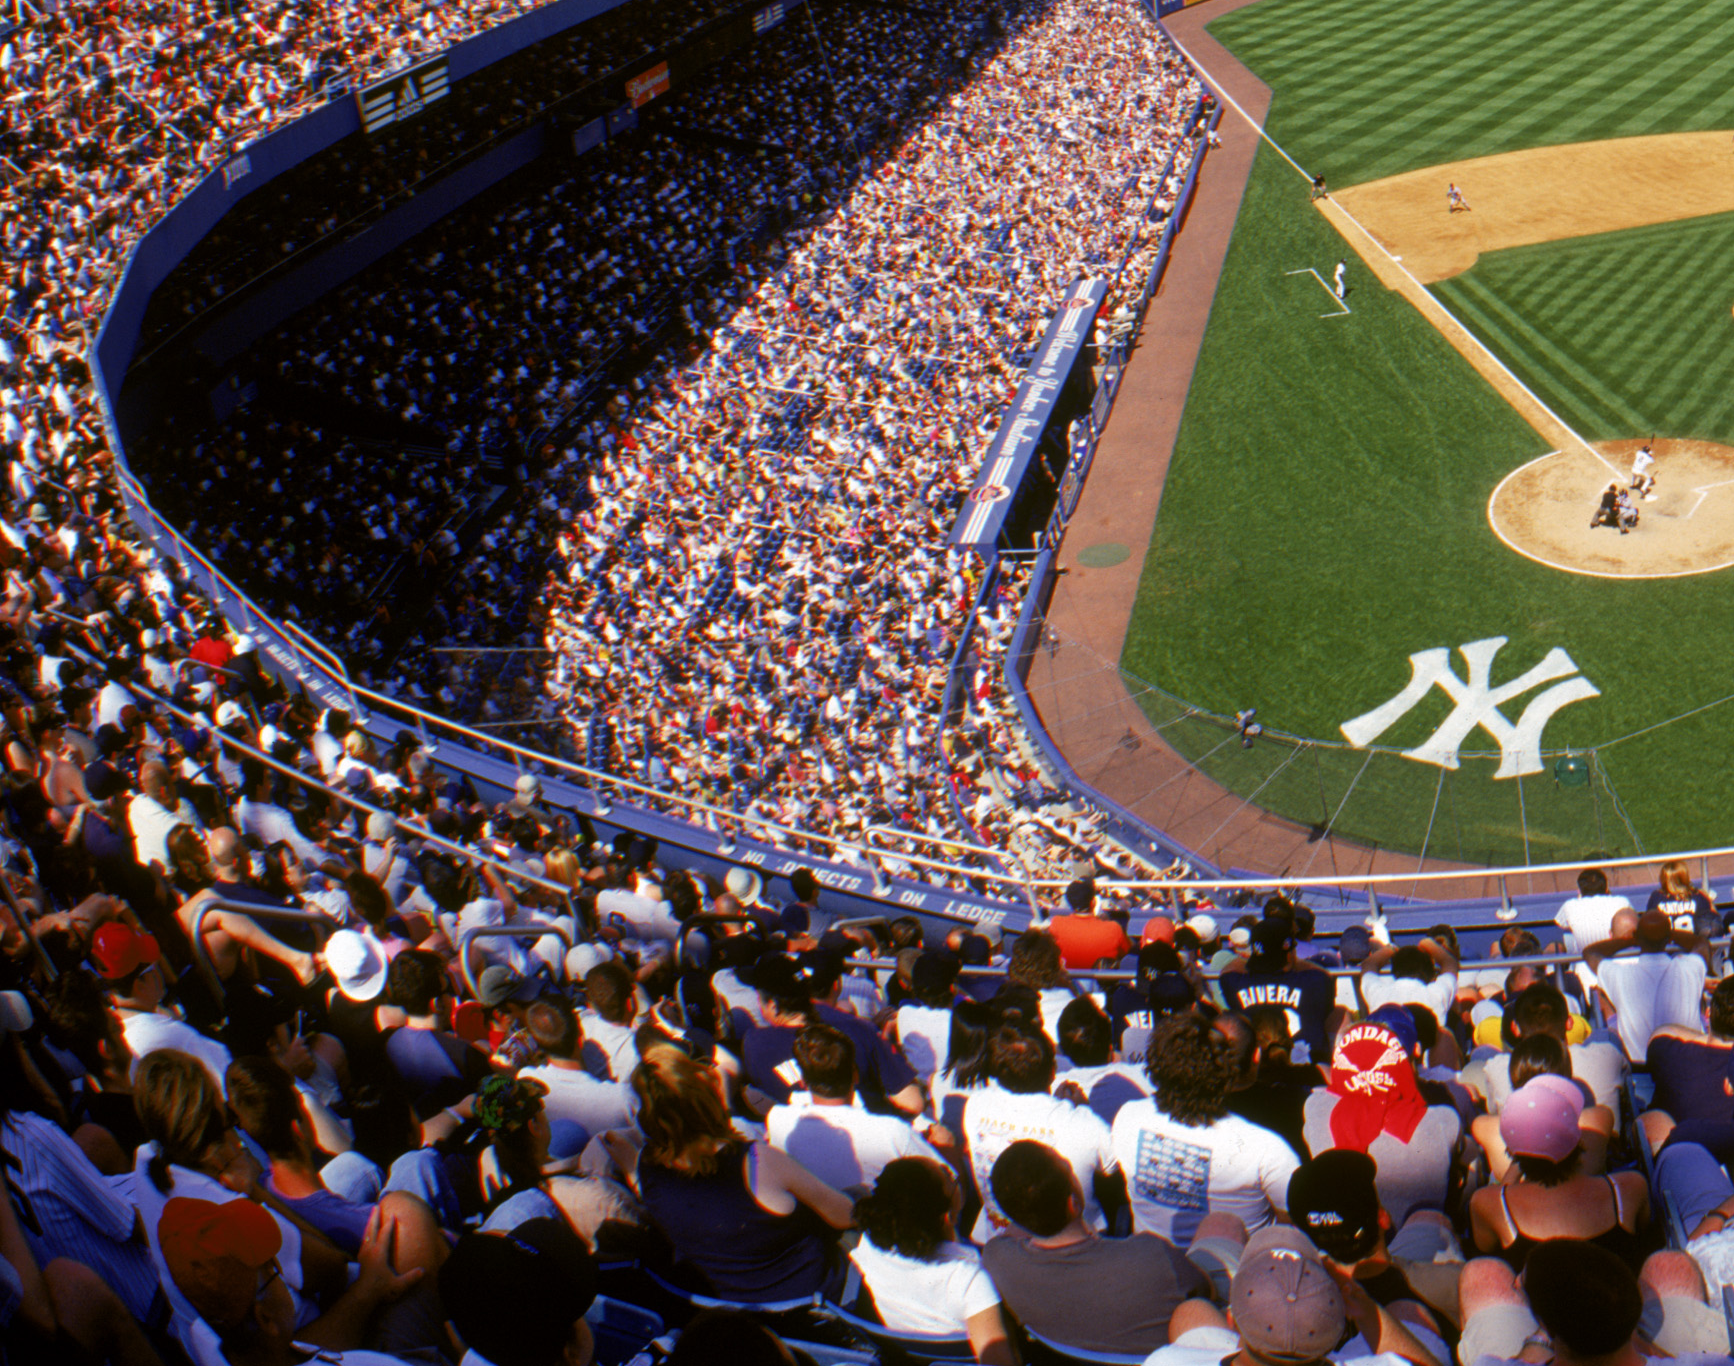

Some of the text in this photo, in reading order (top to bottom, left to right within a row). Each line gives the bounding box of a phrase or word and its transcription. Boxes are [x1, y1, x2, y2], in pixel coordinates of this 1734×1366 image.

[1338, 635, 1602, 780] NY
[741, 850, 766, 866] NO
[900, 890, 928, 907] ON
[943, 899, 1008, 927] LEDGE
[1237, 984, 1302, 1011] RIVERA
